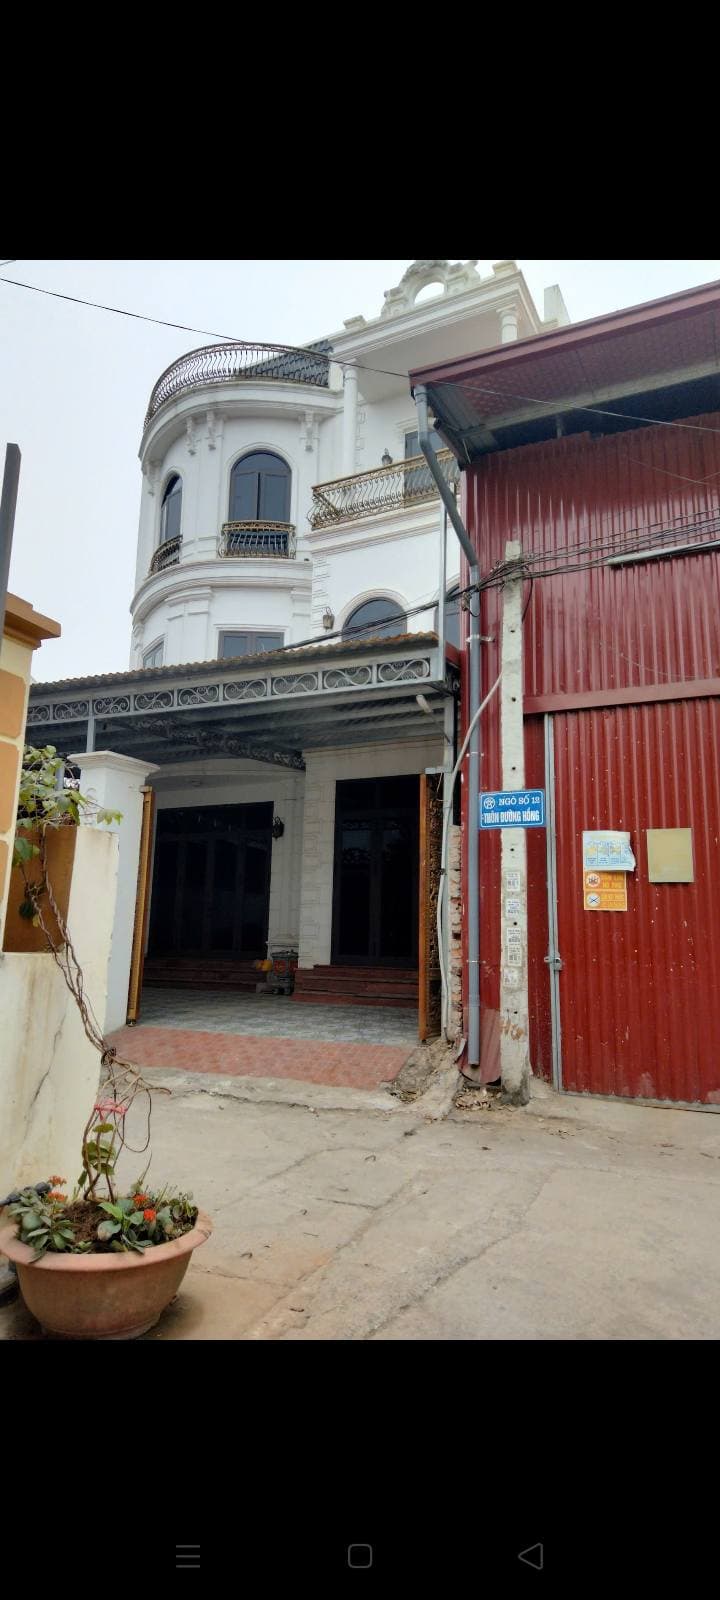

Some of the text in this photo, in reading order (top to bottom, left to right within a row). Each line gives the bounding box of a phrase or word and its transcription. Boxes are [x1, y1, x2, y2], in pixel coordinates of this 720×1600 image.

[518, 793, 530, 805] SỐ
[531, 796, 540, 804] 12
[484, 810, 499, 824] THÔN
